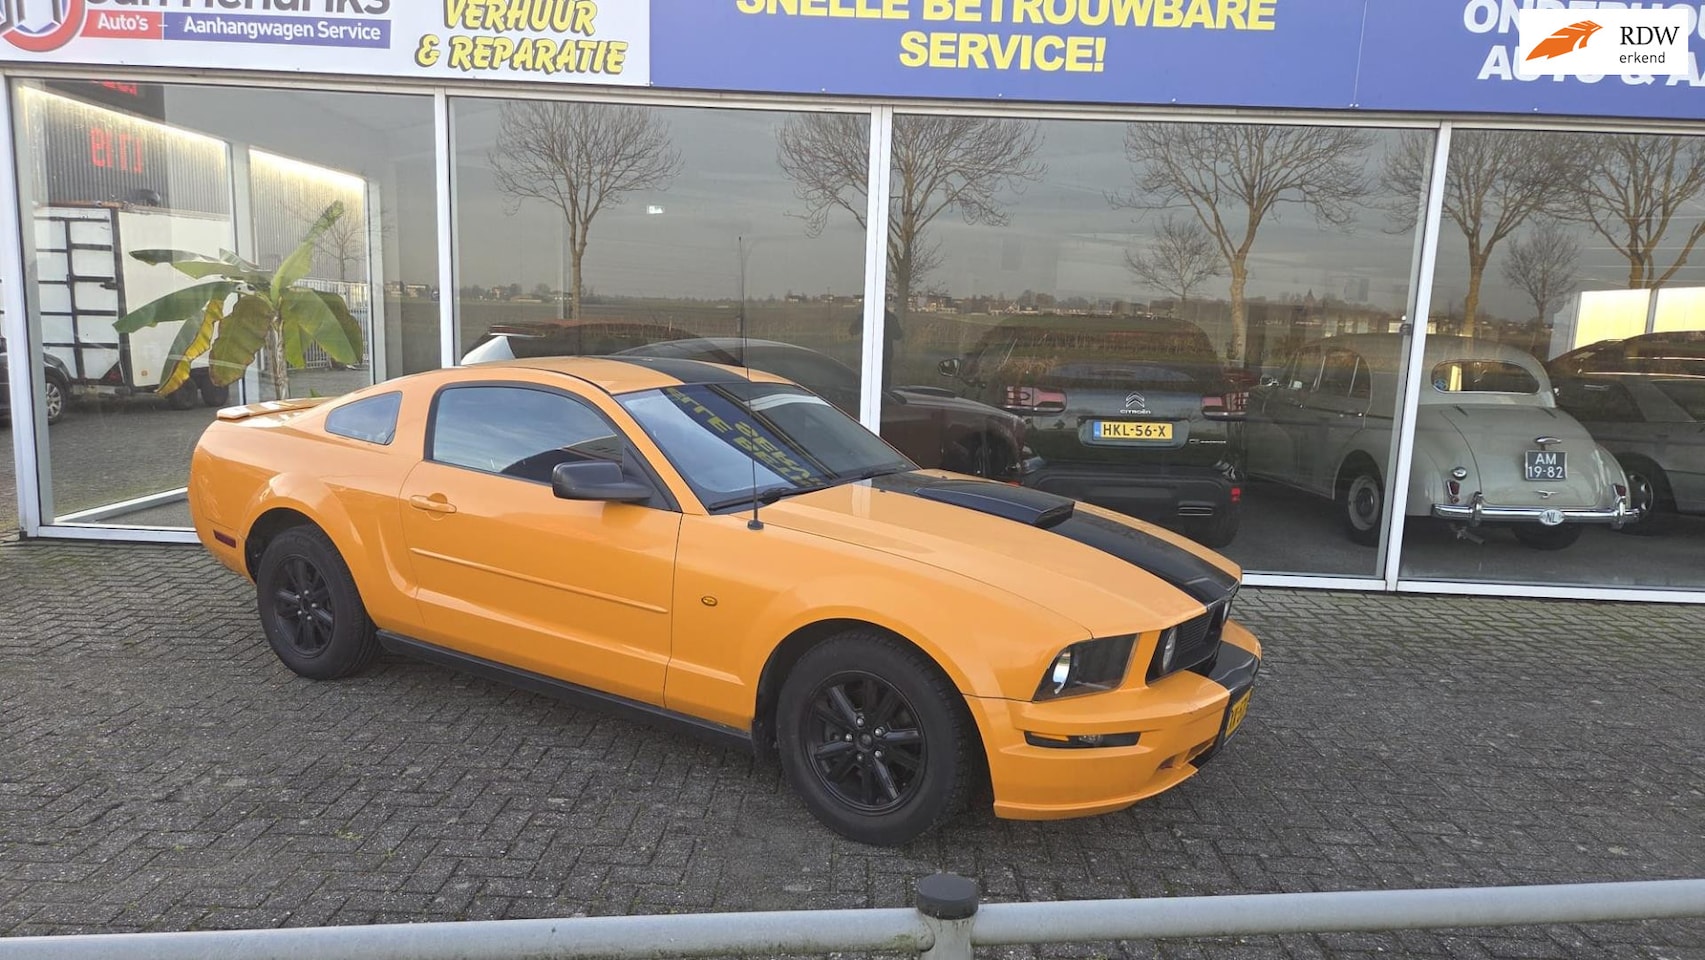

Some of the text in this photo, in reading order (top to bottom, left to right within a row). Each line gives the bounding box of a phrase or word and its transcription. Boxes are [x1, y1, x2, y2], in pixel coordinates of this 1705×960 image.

[97, 12, 381, 41] Auto's Aanhangwagen Service
[443, 0, 598, 35] VERHUUR
[922, 0, 1276, 31] BETROUWBARE
[415, 34, 628, 75] & REPARATIE
[899, 30, 1107, 72] SERVICE!
[1103, 423, 1167, 438] HKL-56-X
[1528, 466, 1564, 479] 19-82
[1534, 453, 1557, 465] AM
[1545, 511, 1558, 524] NL
